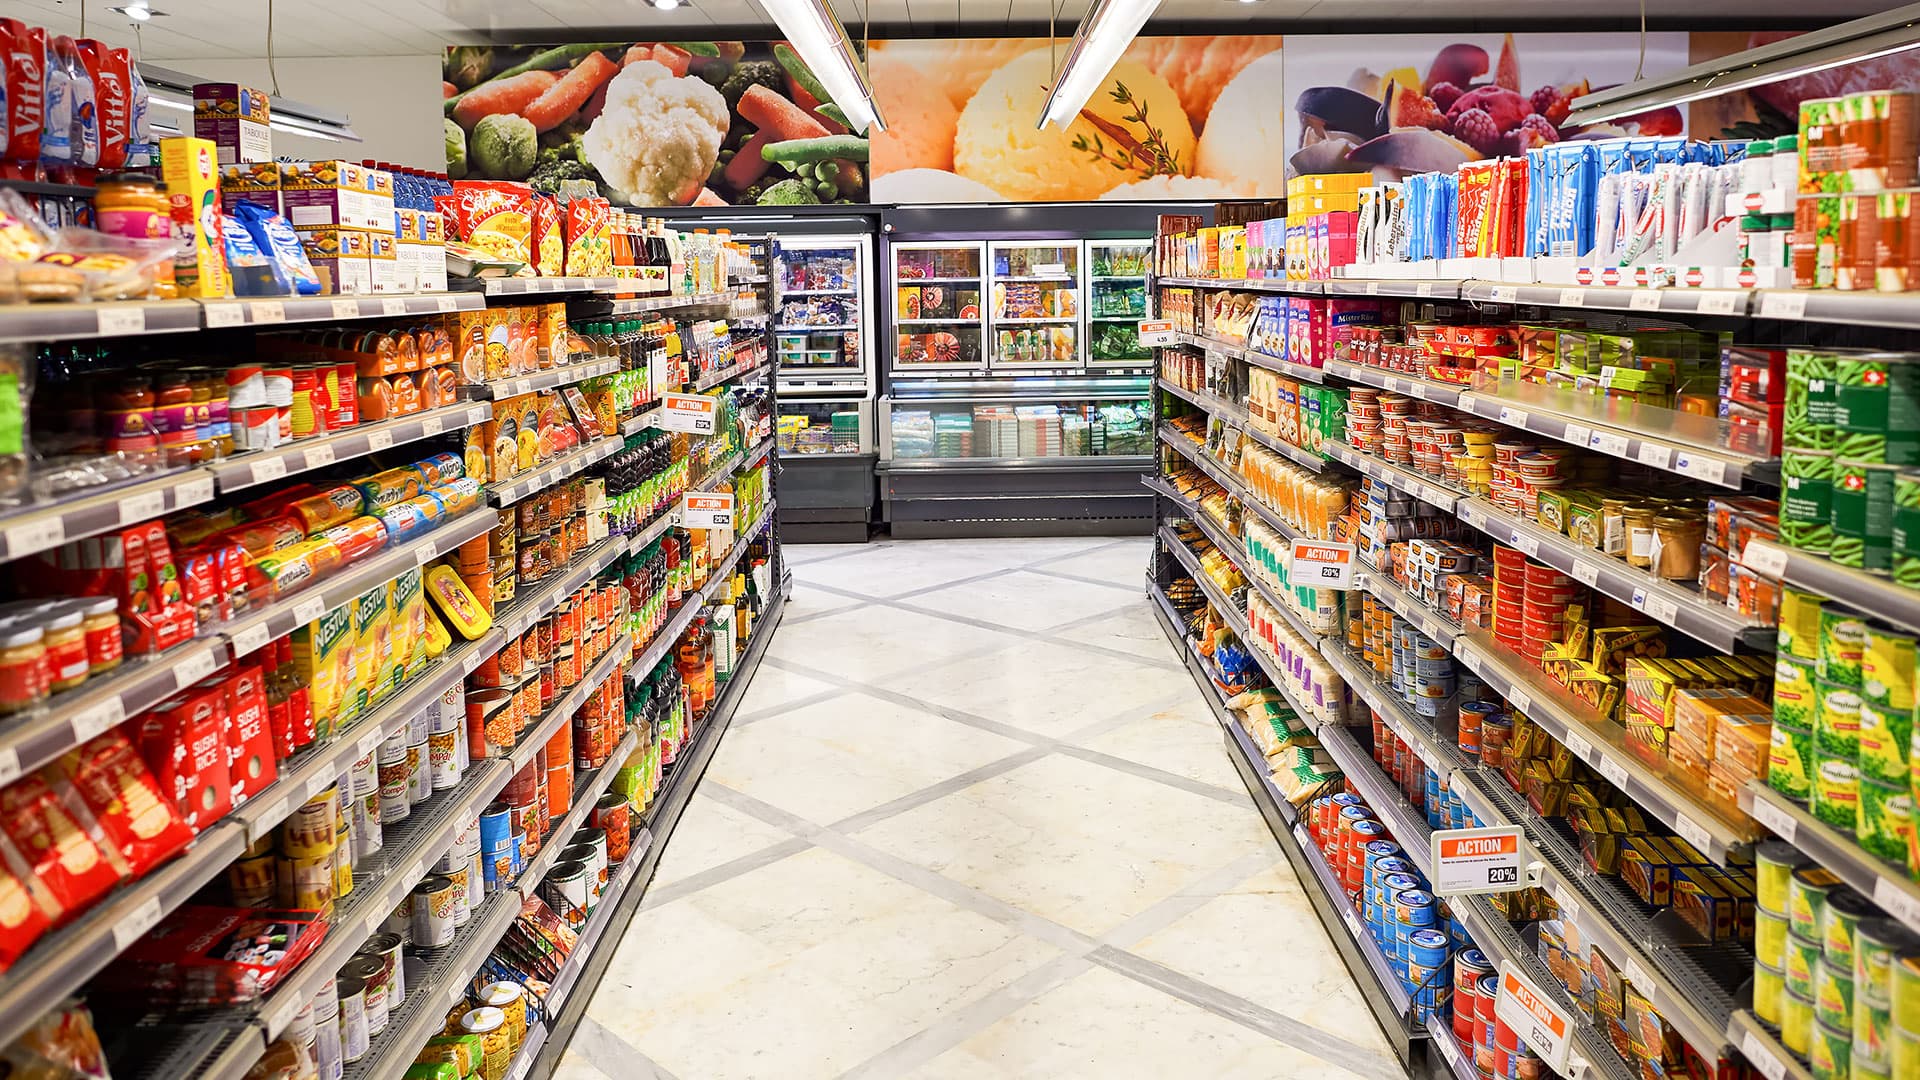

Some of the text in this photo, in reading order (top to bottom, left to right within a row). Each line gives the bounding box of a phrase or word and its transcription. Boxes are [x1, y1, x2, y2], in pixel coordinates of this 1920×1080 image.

[11, 52, 41, 137] Vittel
[98, 72, 127, 147] Vittel
[1385, 202, 1399, 257] Leberpains
[1466, 190, 1490, 253] Sandwich
[676, 400, 703, 411] ACTION
[695, 499, 722, 508] ACTION
[714, 515, 729, 524] 20%
[1306, 548, 1339, 561] ACTION
[1322, 568, 1339, 577] 20%
[353, 583, 388, 630] NESTUM
[237, 704, 260, 729] SUSHI
[240, 720, 261, 743] RICE
[192, 731, 218, 757] SUSHI
[195, 748, 218, 772] RICE
[1456, 838, 1502, 855] ACTION
[1490, 868, 1516, 882] 20%
[1515, 986, 1553, 1026] ACTION
